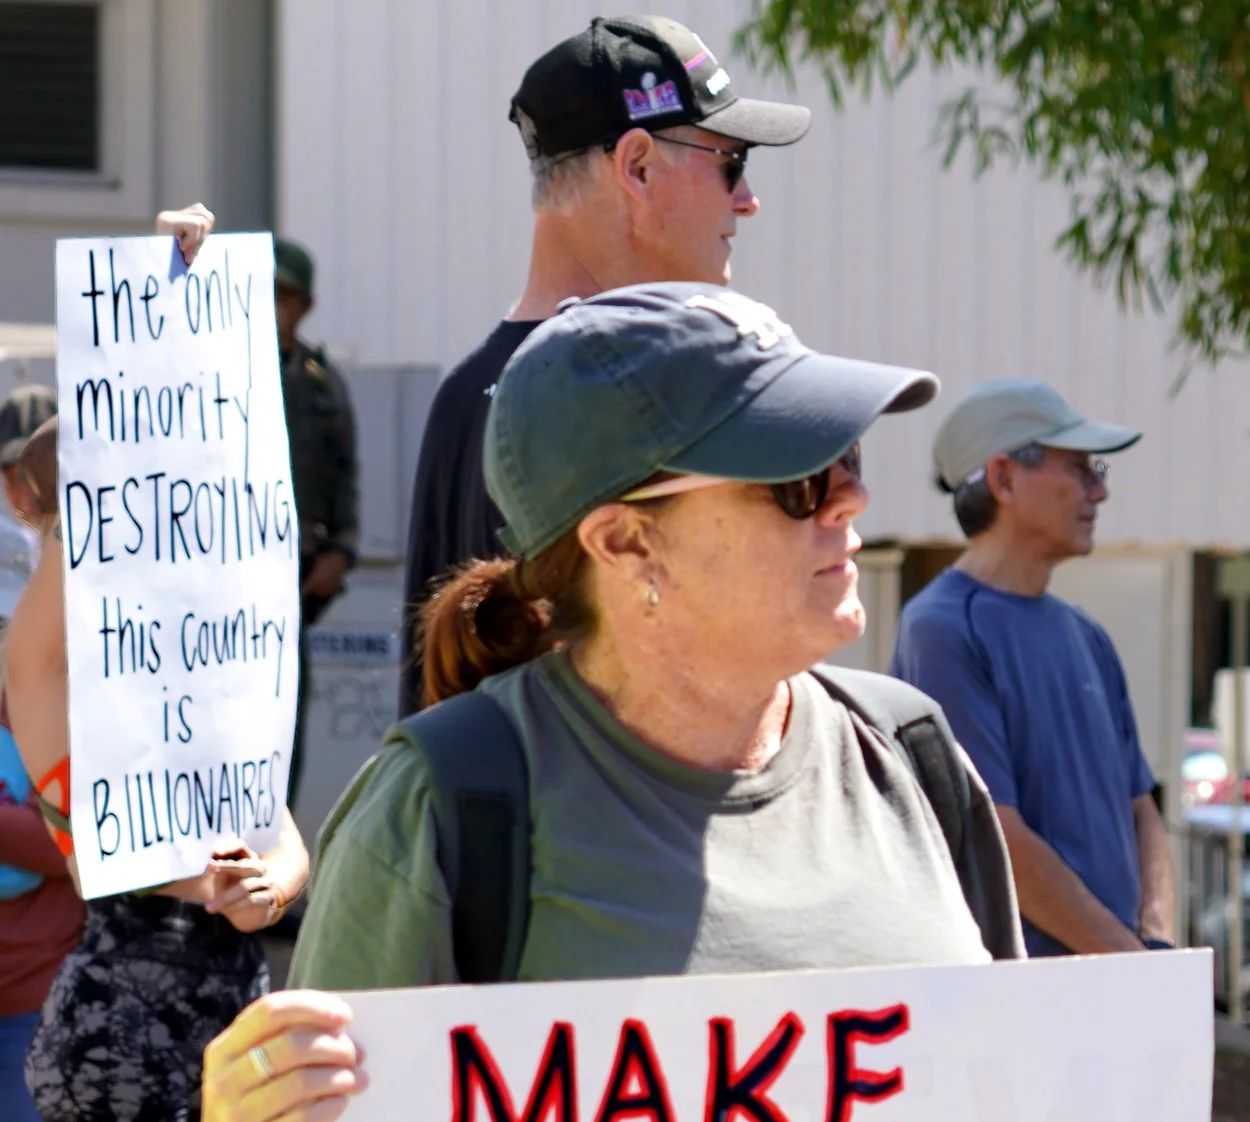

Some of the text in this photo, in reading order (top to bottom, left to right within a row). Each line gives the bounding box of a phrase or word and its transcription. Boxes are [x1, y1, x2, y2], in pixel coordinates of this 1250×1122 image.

[80, 247, 252, 390] the only
[75, 370, 252, 488] minority
[65, 470, 293, 571] DESTROYING
[98, 596, 162, 679] this
[162, 685, 195, 745] is
[92, 750, 281, 863] BILLIONAIRES
